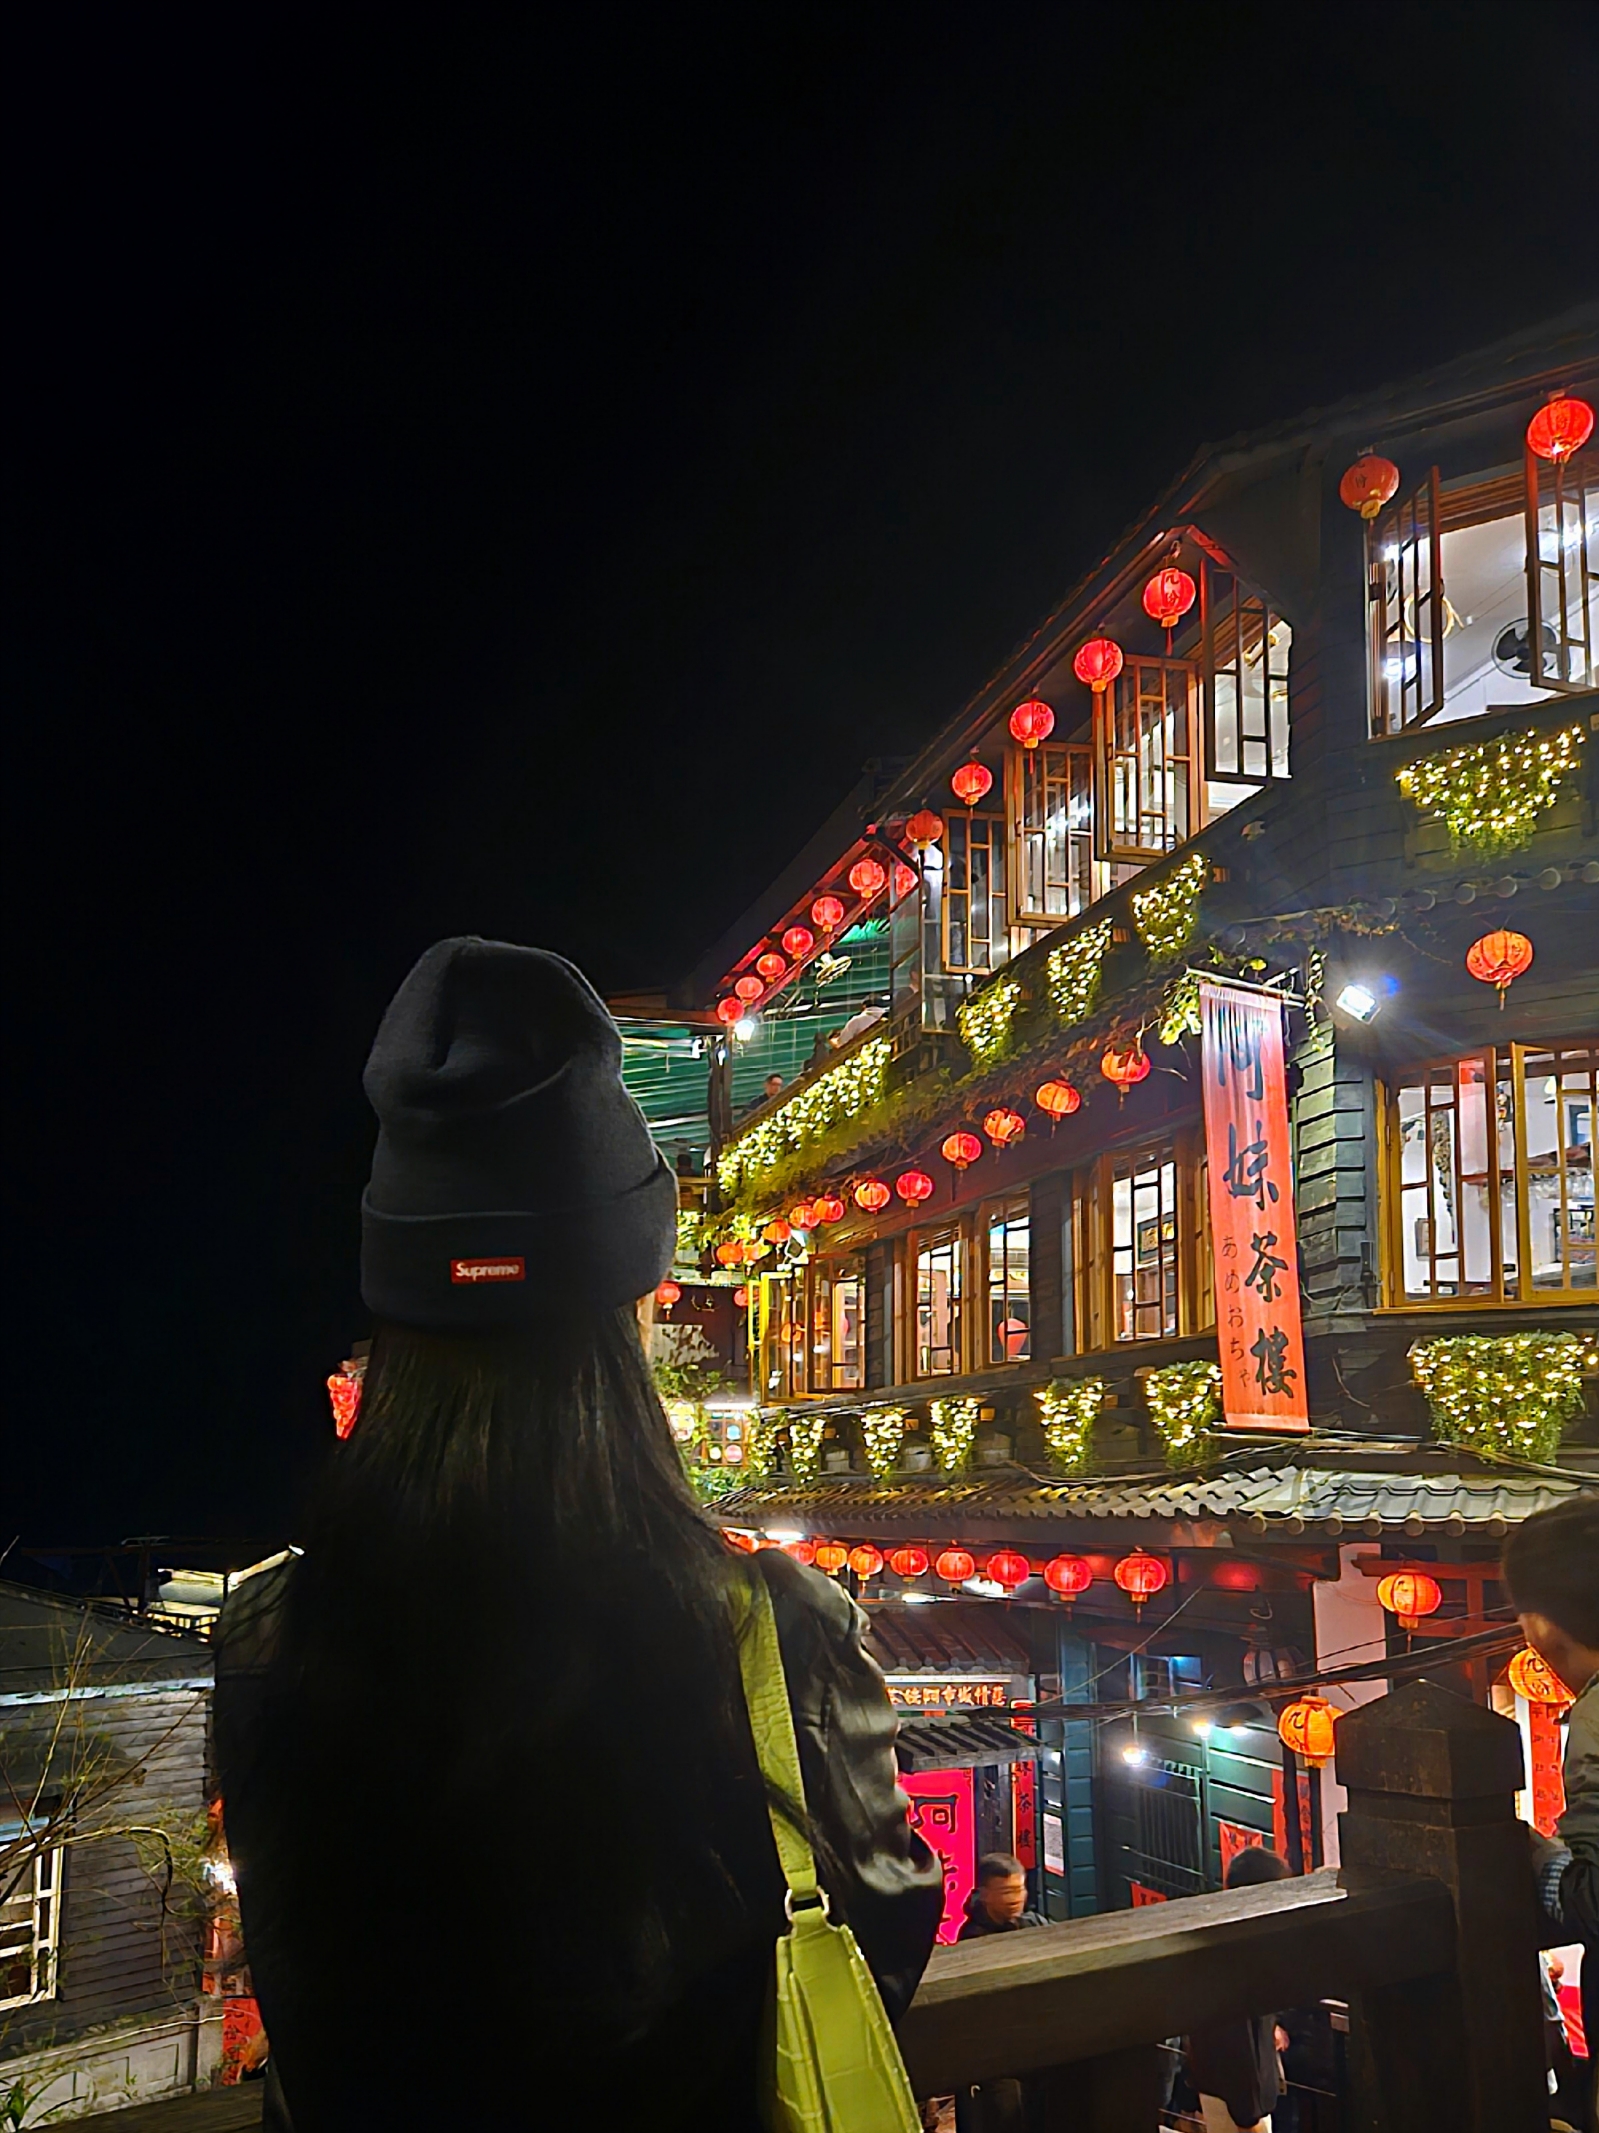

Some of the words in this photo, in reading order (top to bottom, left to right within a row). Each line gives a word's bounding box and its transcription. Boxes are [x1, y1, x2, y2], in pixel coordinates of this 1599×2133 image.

[1165, 574, 1180, 605] 九份
[455, 1262, 519, 1281] Supreme
[1222, 1235, 1251, 1388] あめおちゃ
[1526, 1656, 1552, 1697] 九份
